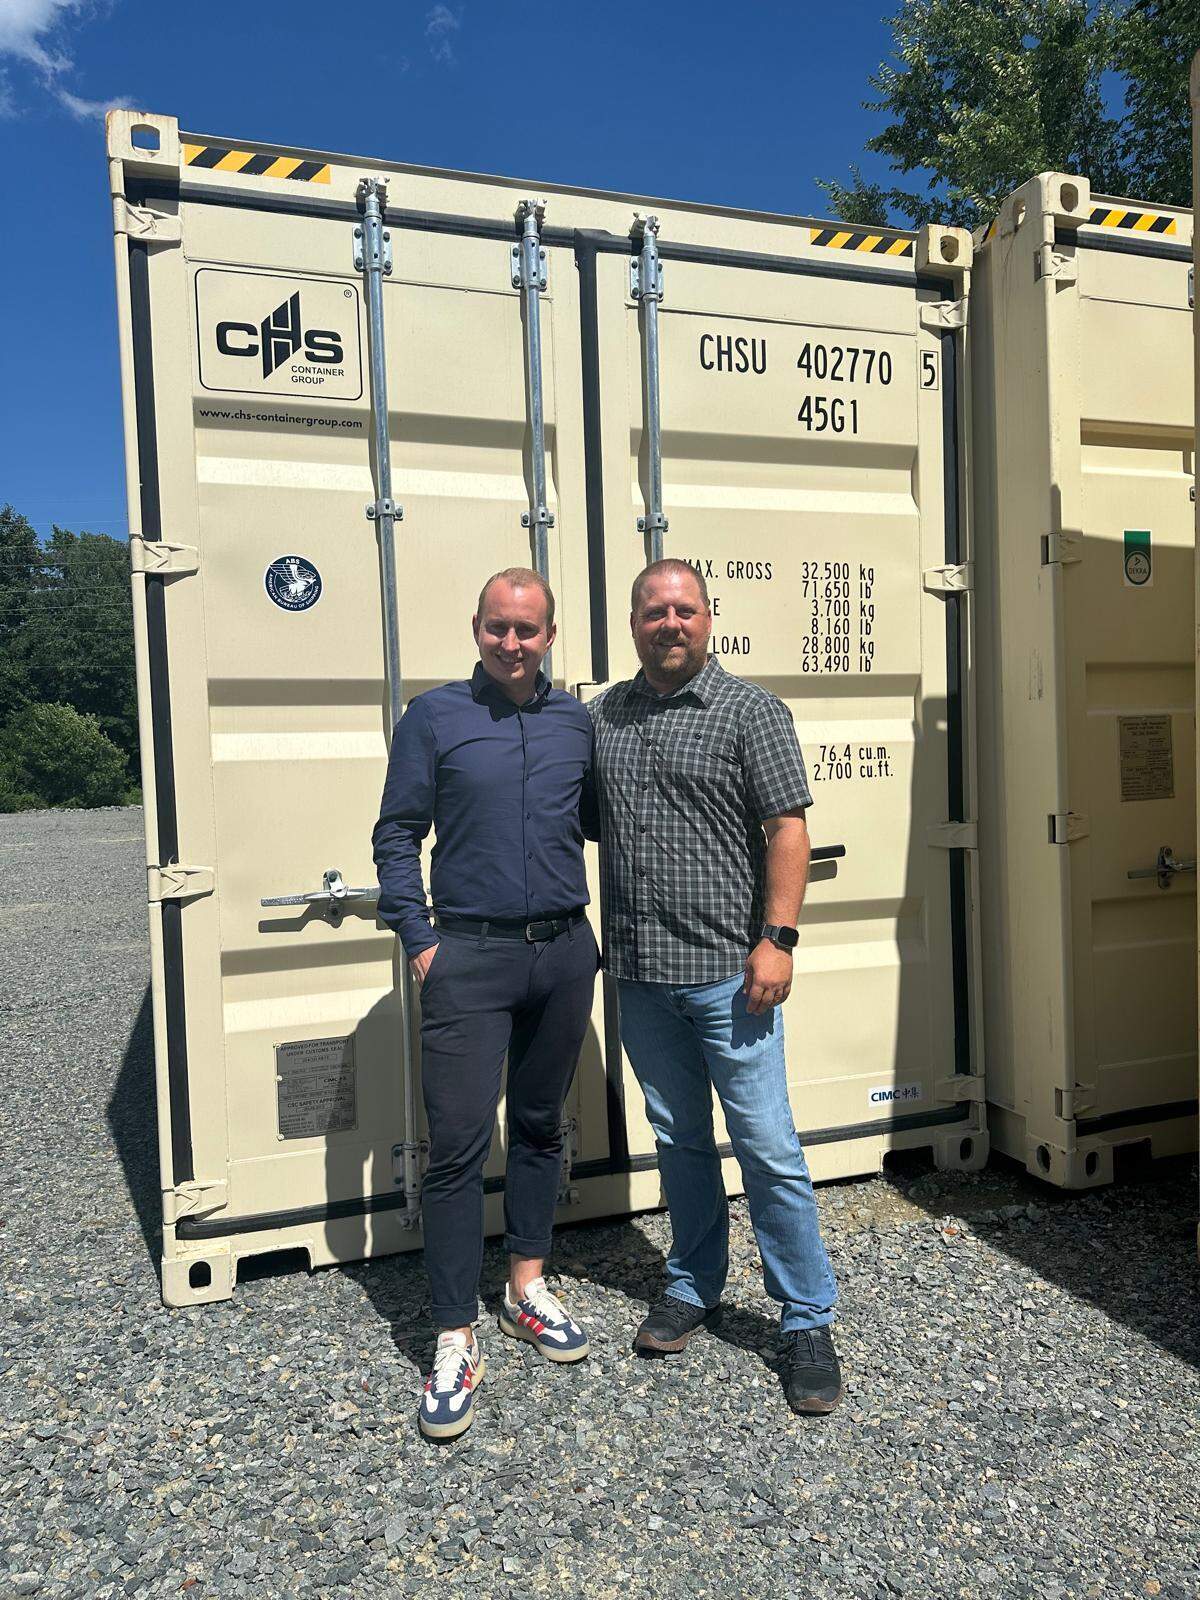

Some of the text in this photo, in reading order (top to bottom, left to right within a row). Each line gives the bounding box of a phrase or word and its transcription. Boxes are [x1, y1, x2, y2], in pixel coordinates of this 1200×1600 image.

[216, 290, 344, 380] CHS
[700, 333, 936, 387] CHSU 402770 5
[291, 366, 344, 377] CONTAINER
[291, 376, 325, 385] GROUP
[200, 409, 362, 428] www.chs-containergroup.com
[797, 395, 858, 434] 45G1
[727, 561, 772, 580] GROSS
[802, 561, 849, 581] 32,500
[860, 563, 874, 586] kg
[802, 580, 871, 599] 71,650 lb
[277, 598, 297, 608] BUREAU
[811, 599, 874, 622] 3,700 kg
[811, 618, 871, 636] 8,160 lb
[712, 635, 874, 659] LOAD 28,800 kg
[802, 655, 871, 674] 63,490 lb
[820, 744, 890, 762] 76.4 cu.m.
[860, 760, 893, 778] cu.ft.
[871, 1089, 900, 1102] CIMC
